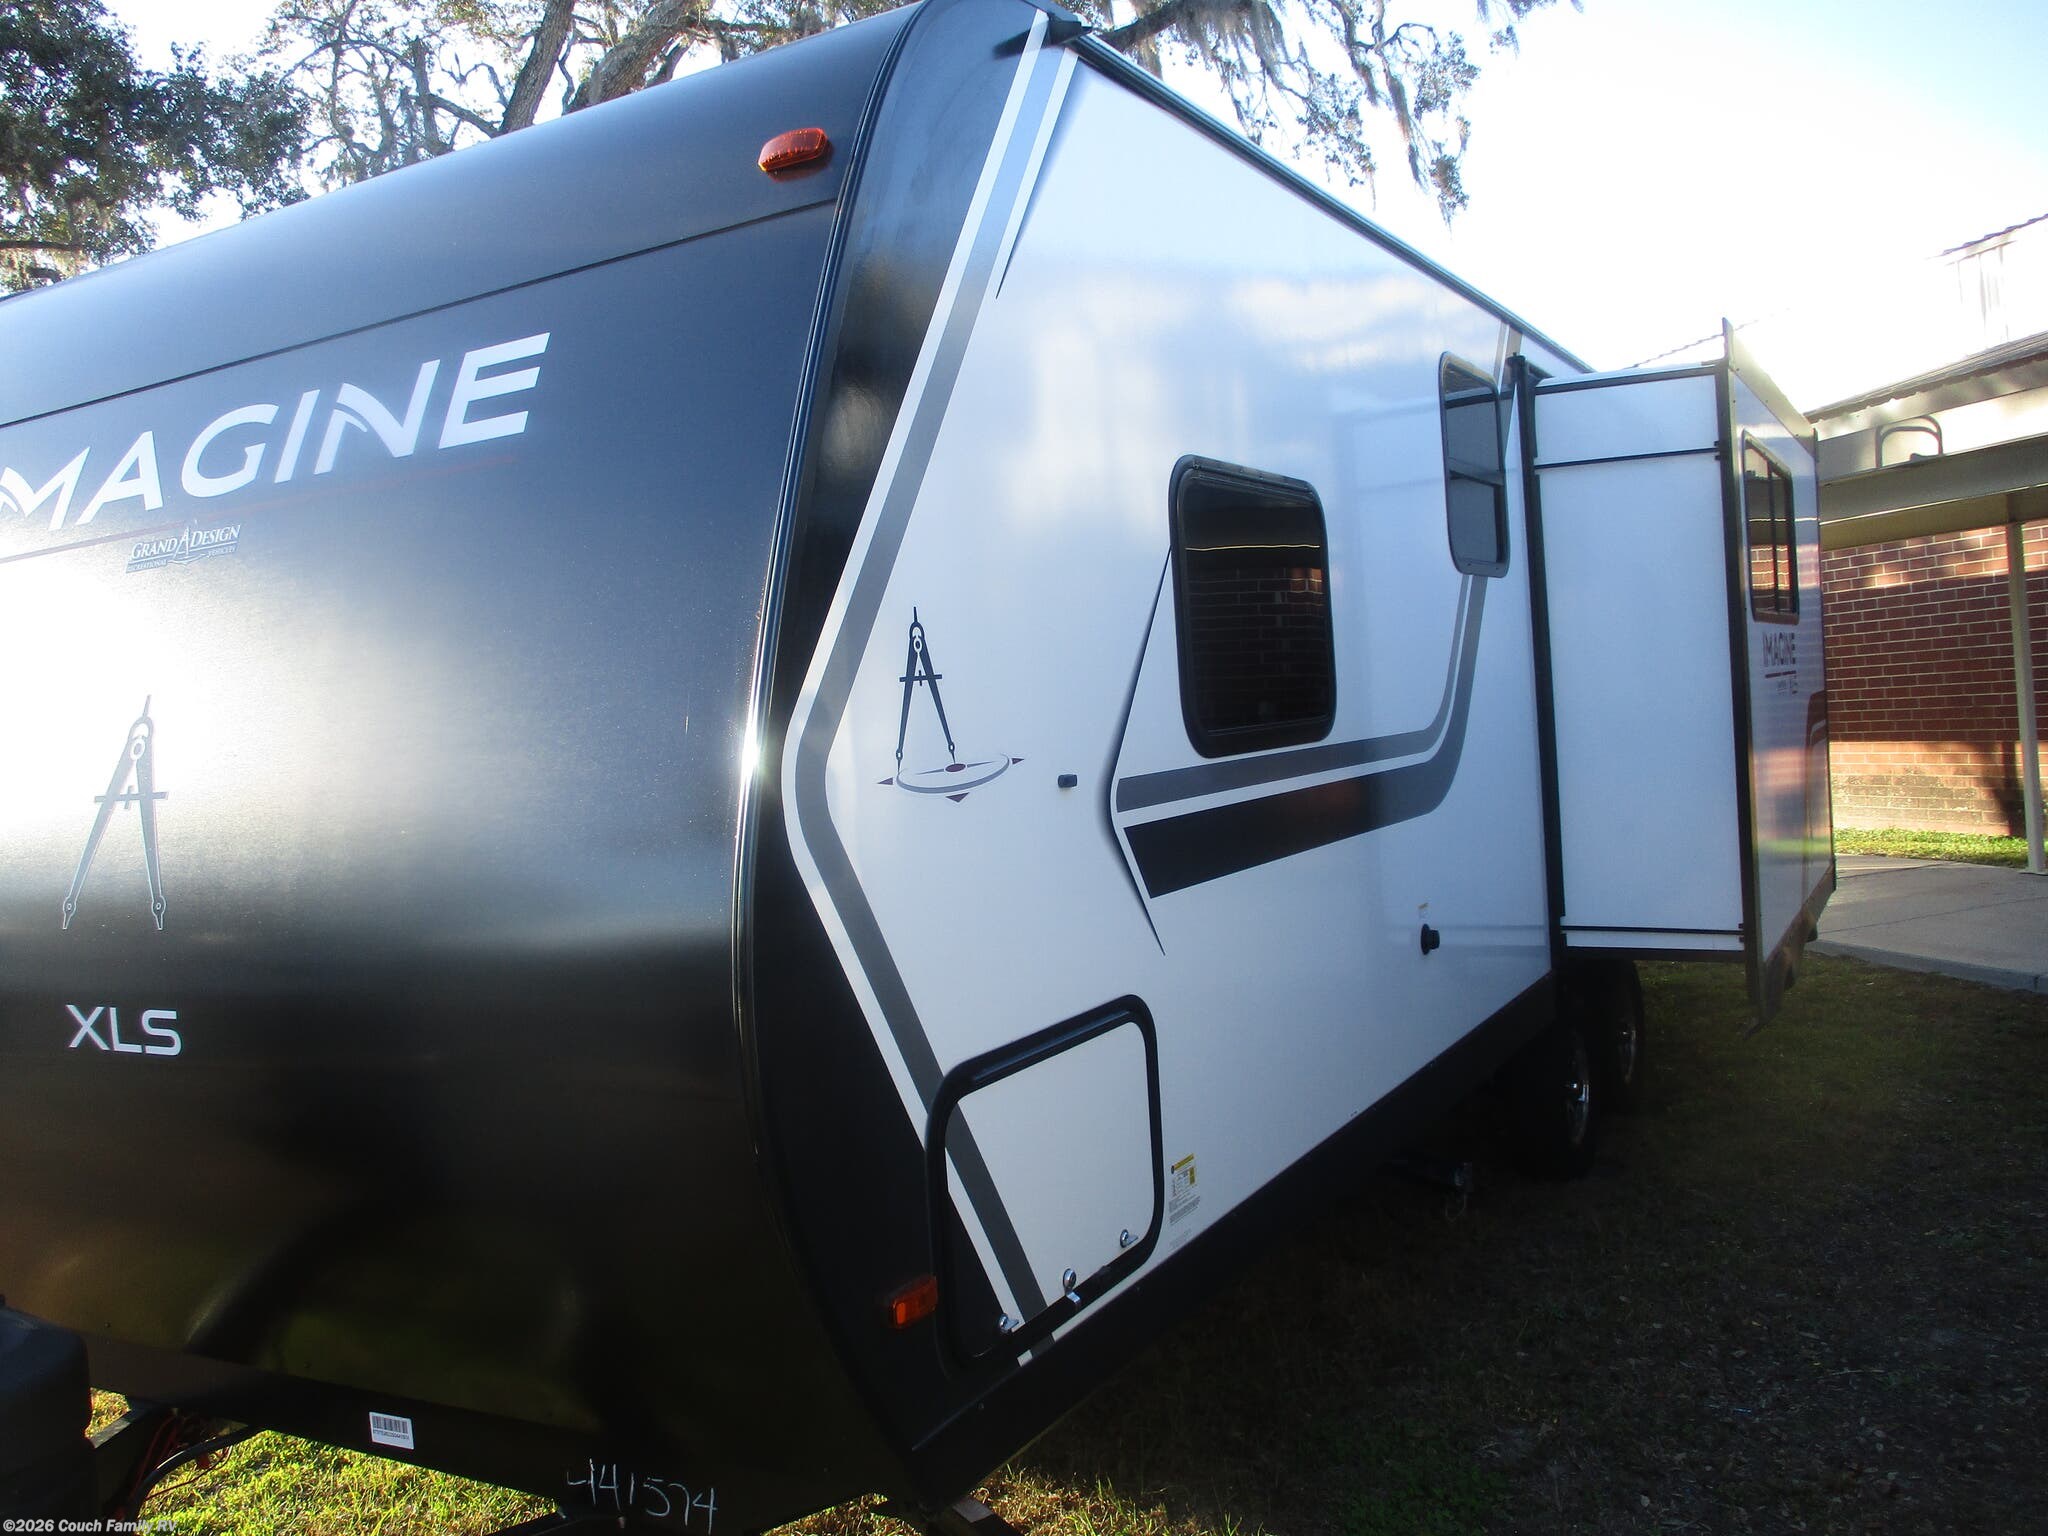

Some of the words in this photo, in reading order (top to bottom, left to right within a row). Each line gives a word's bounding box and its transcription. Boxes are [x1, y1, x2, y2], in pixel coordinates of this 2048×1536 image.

[131, 537, 178, 560] GRAND
[190, 524, 241, 548] DESIGN
[1762, 631, 1796, 667] IMAGINE
[65, 1004, 182, 1056] XLS
[566, 1458, 718, 1535] 441574
